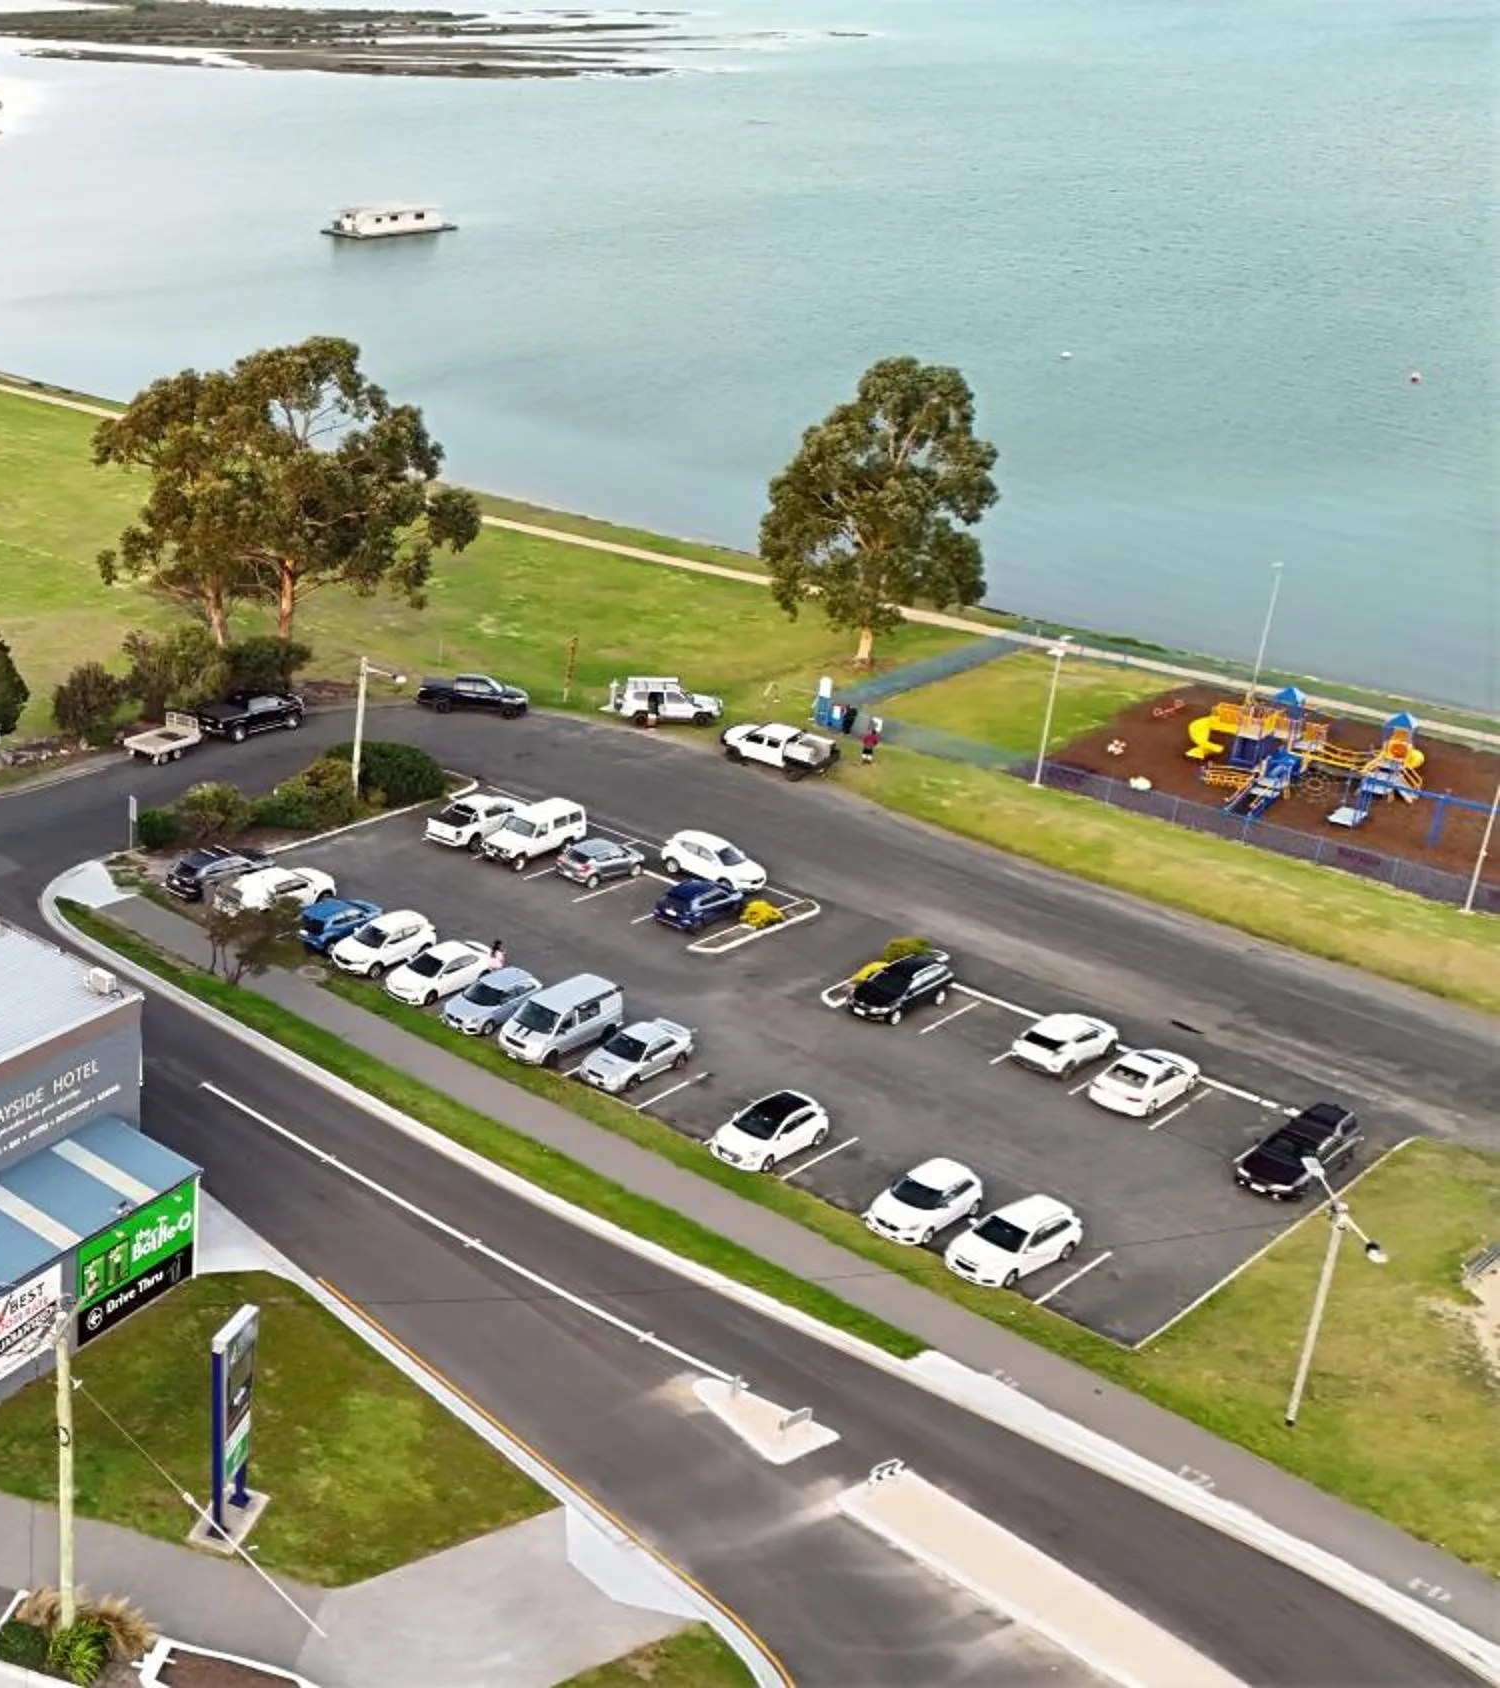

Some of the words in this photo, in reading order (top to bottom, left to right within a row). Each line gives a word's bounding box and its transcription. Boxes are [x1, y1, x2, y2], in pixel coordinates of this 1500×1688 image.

[53, 1060, 99, 1094] HOTEL
[10, 1282, 45, 1314] BEST
[106, 1288, 136, 1313] Drive
[137, 1271, 164, 1293] Thru
